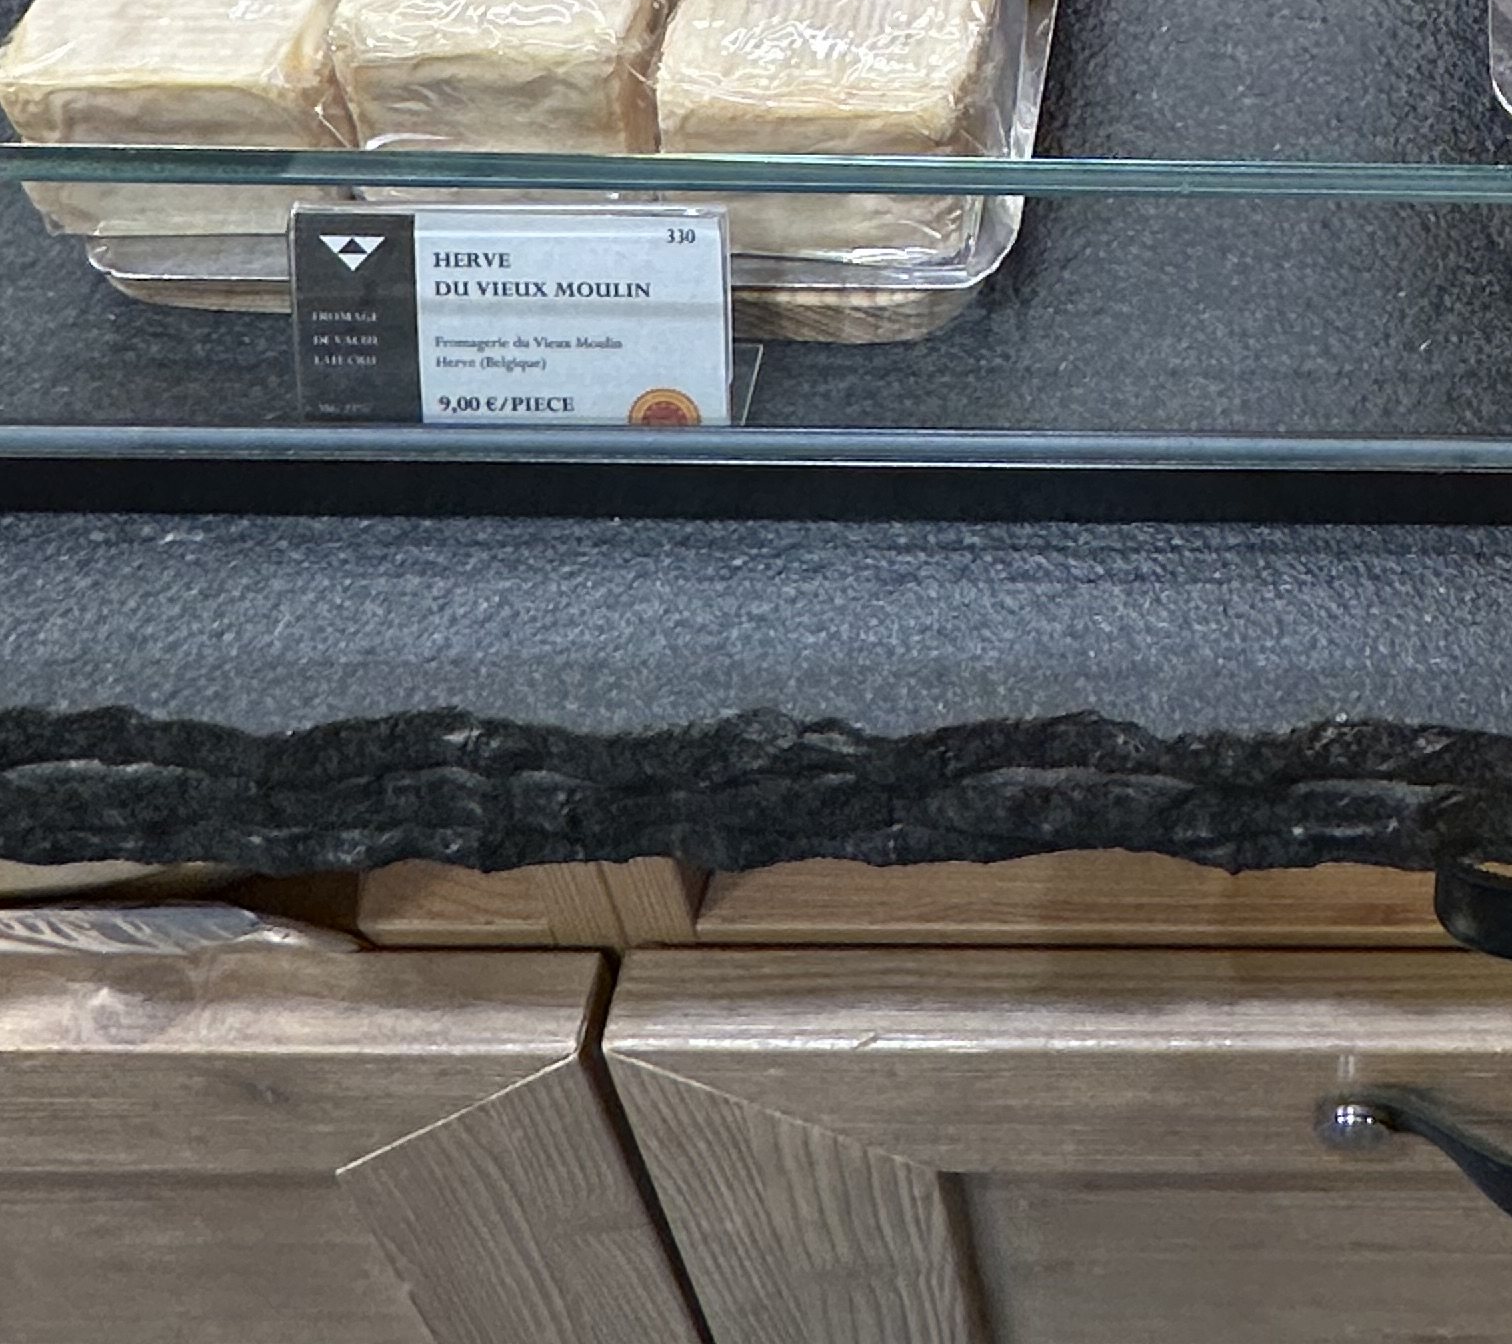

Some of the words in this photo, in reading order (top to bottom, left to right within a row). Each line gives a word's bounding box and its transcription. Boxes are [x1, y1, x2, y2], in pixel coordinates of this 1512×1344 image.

[666, 228, 696, 245] 330
[433, 252, 511, 269] HERVE
[434, 281, 469, 298] DU
[478, 281, 547, 299] VIEUX
[553, 282, 651, 299] MOULIN
[435, 336, 511, 353] Fromagerie
[513, 336, 530, 349] du
[533, 336, 572, 349] Vieux
[575, 336, 623, 350] Moulin
[435, 356, 476, 368] Herve
[480, 355, 547, 373] (Belgique)
[438, 396, 481, 416] 9,00
[486, 395, 575, 412] €/PIECE
